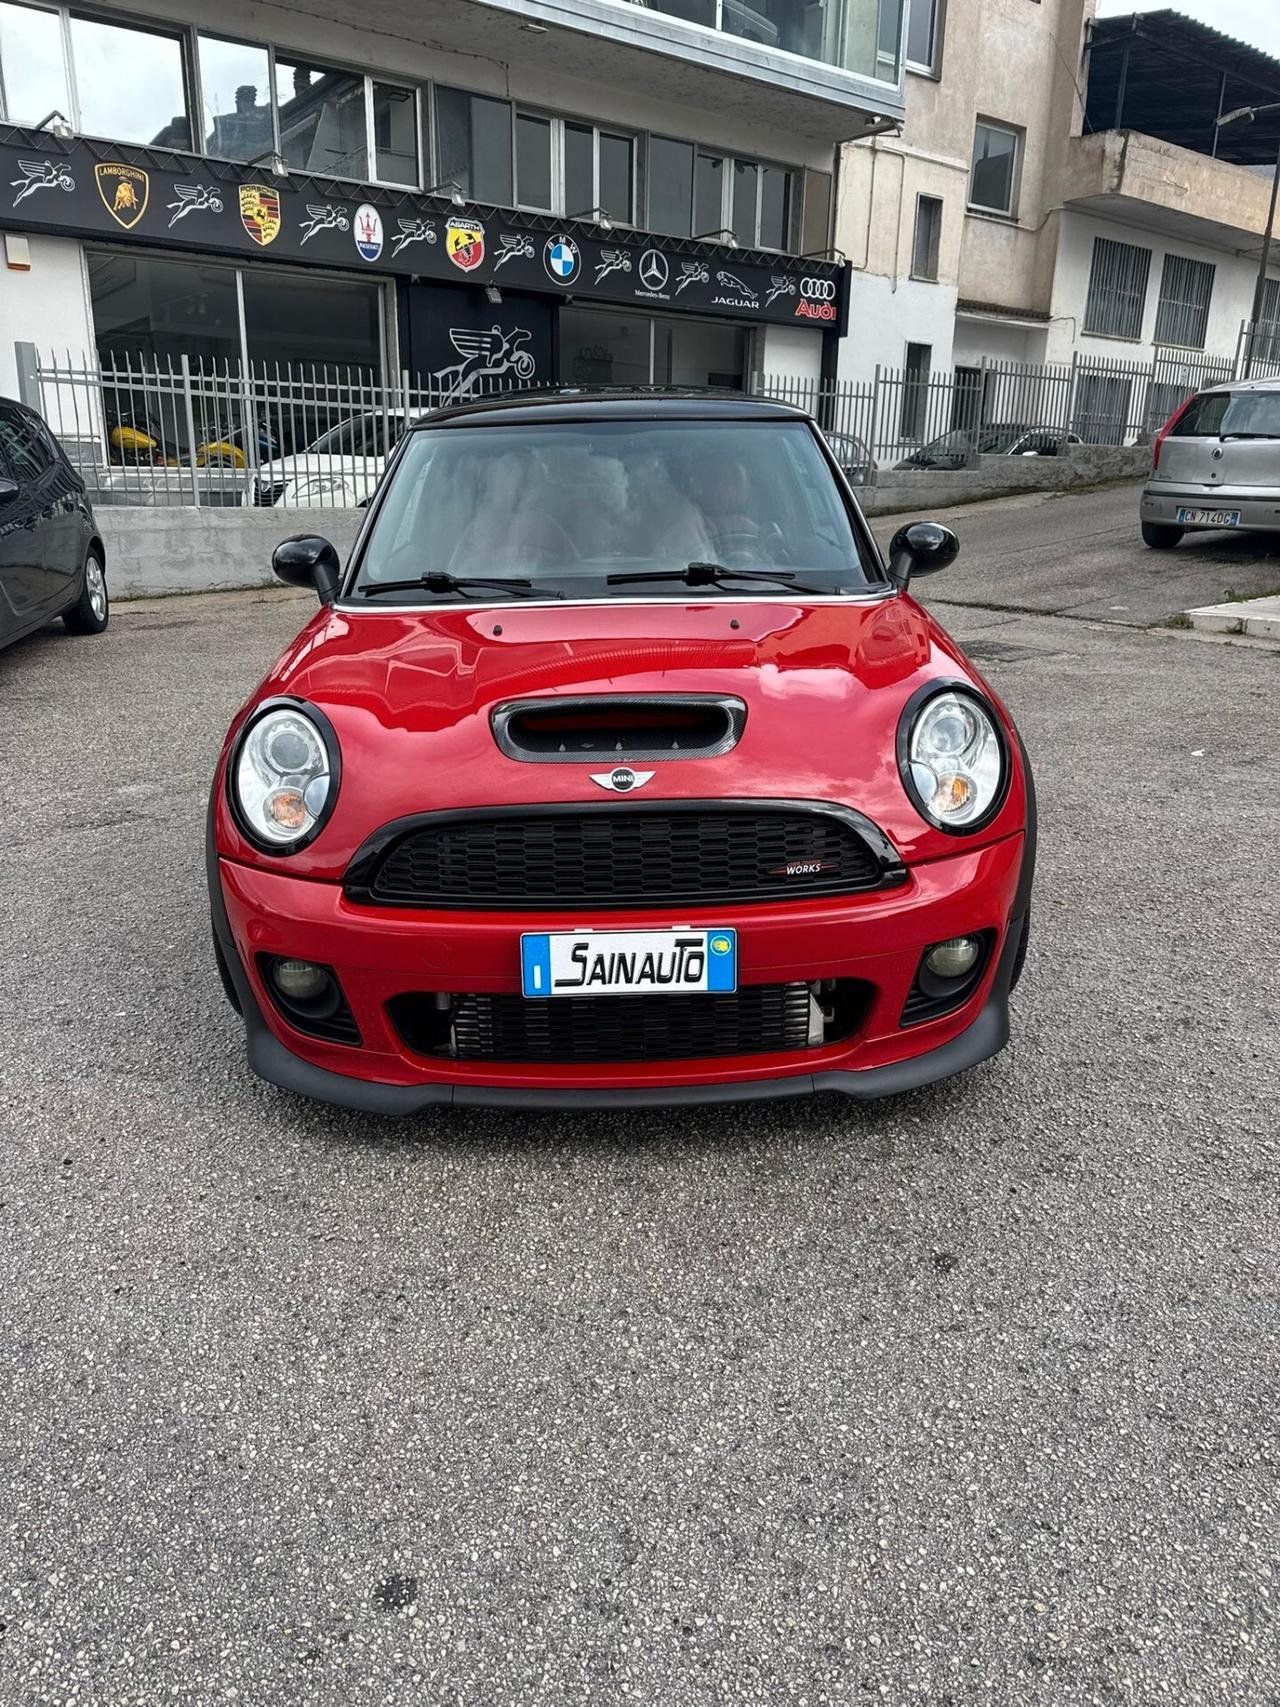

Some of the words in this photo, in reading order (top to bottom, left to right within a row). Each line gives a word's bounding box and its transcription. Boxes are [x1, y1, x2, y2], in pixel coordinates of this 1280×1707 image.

[450, 221, 480, 231] ABARTH
[547, 236, 578, 254] BMW
[711, 296, 759, 309] JAGUAR
[795, 299, 837, 320] Audi
[1184, 510, 1197, 521] CN
[786, 863, 821, 874] WORKS
